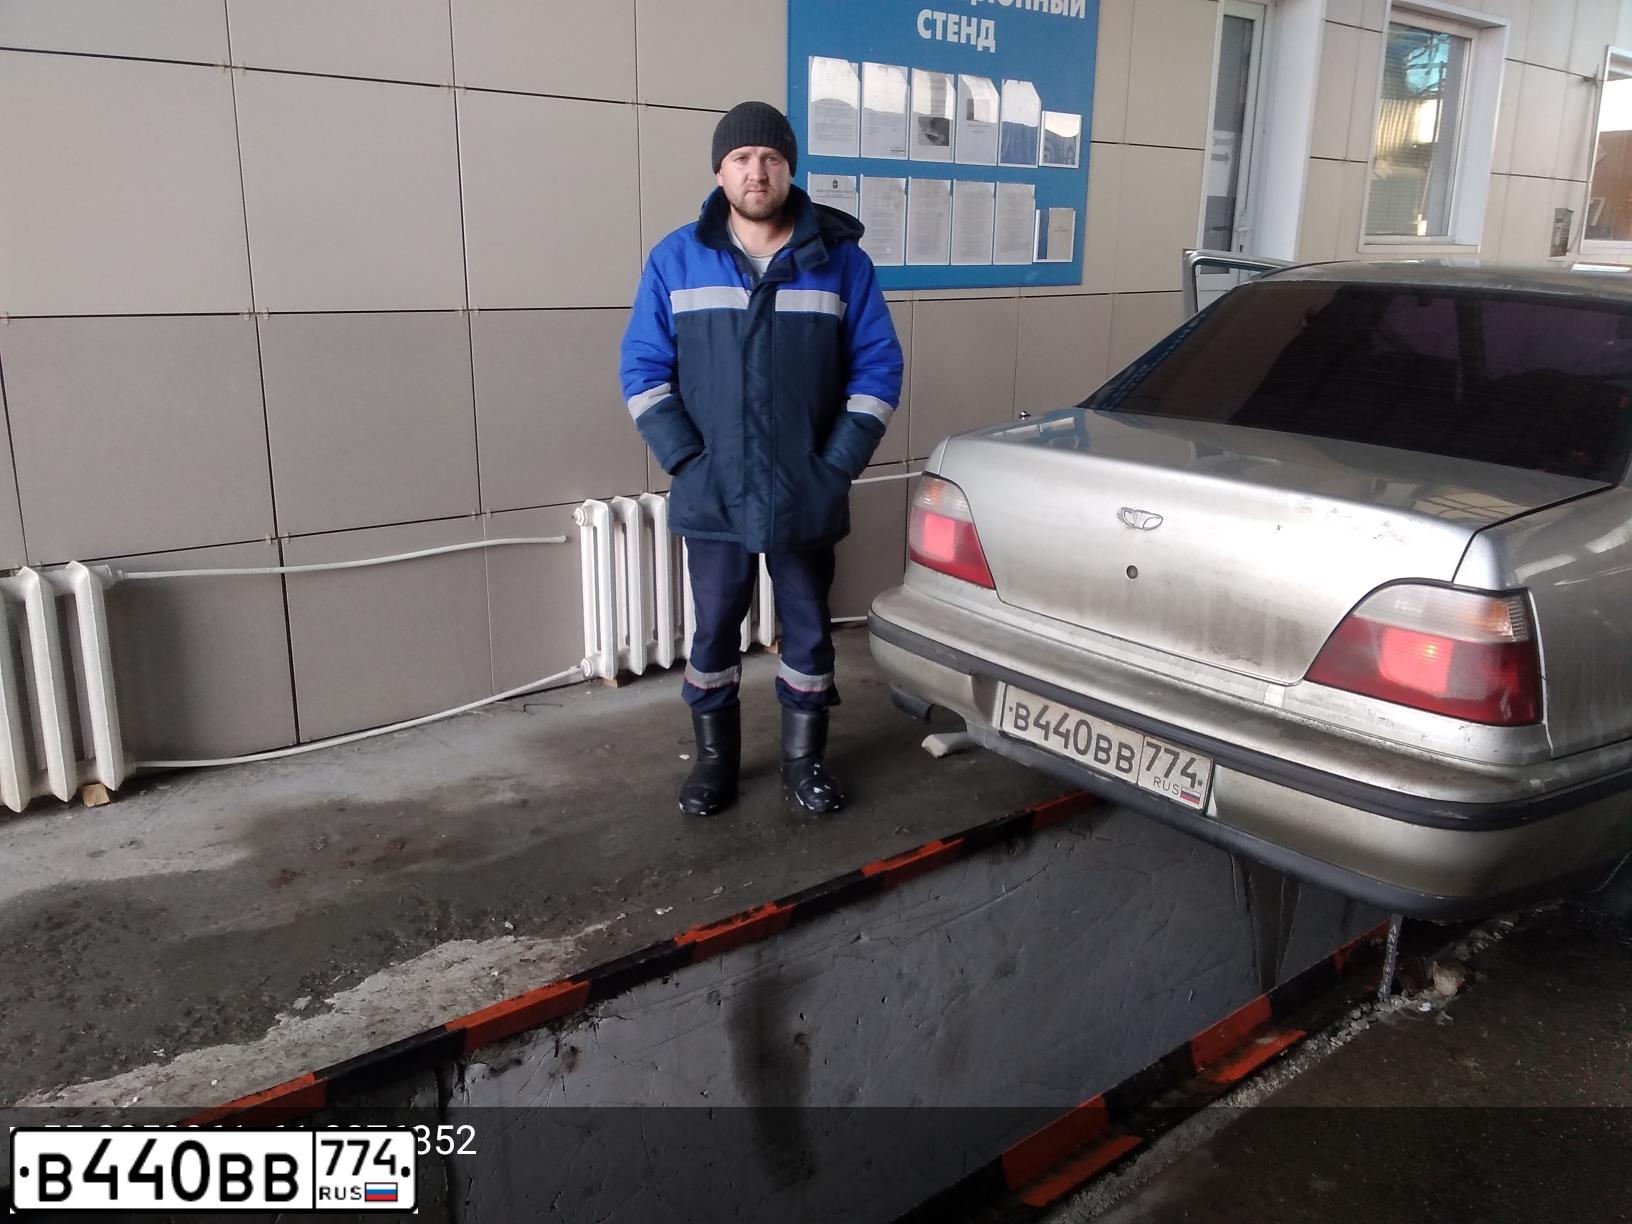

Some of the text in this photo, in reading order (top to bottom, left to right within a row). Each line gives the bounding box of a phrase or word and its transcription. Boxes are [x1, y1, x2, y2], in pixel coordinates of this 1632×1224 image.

[917, 9, 996, 53] СТЕНД
[1013, 701, 1198, 789] В440ВВ 774
[1153, 776, 1179, 795] RUS
